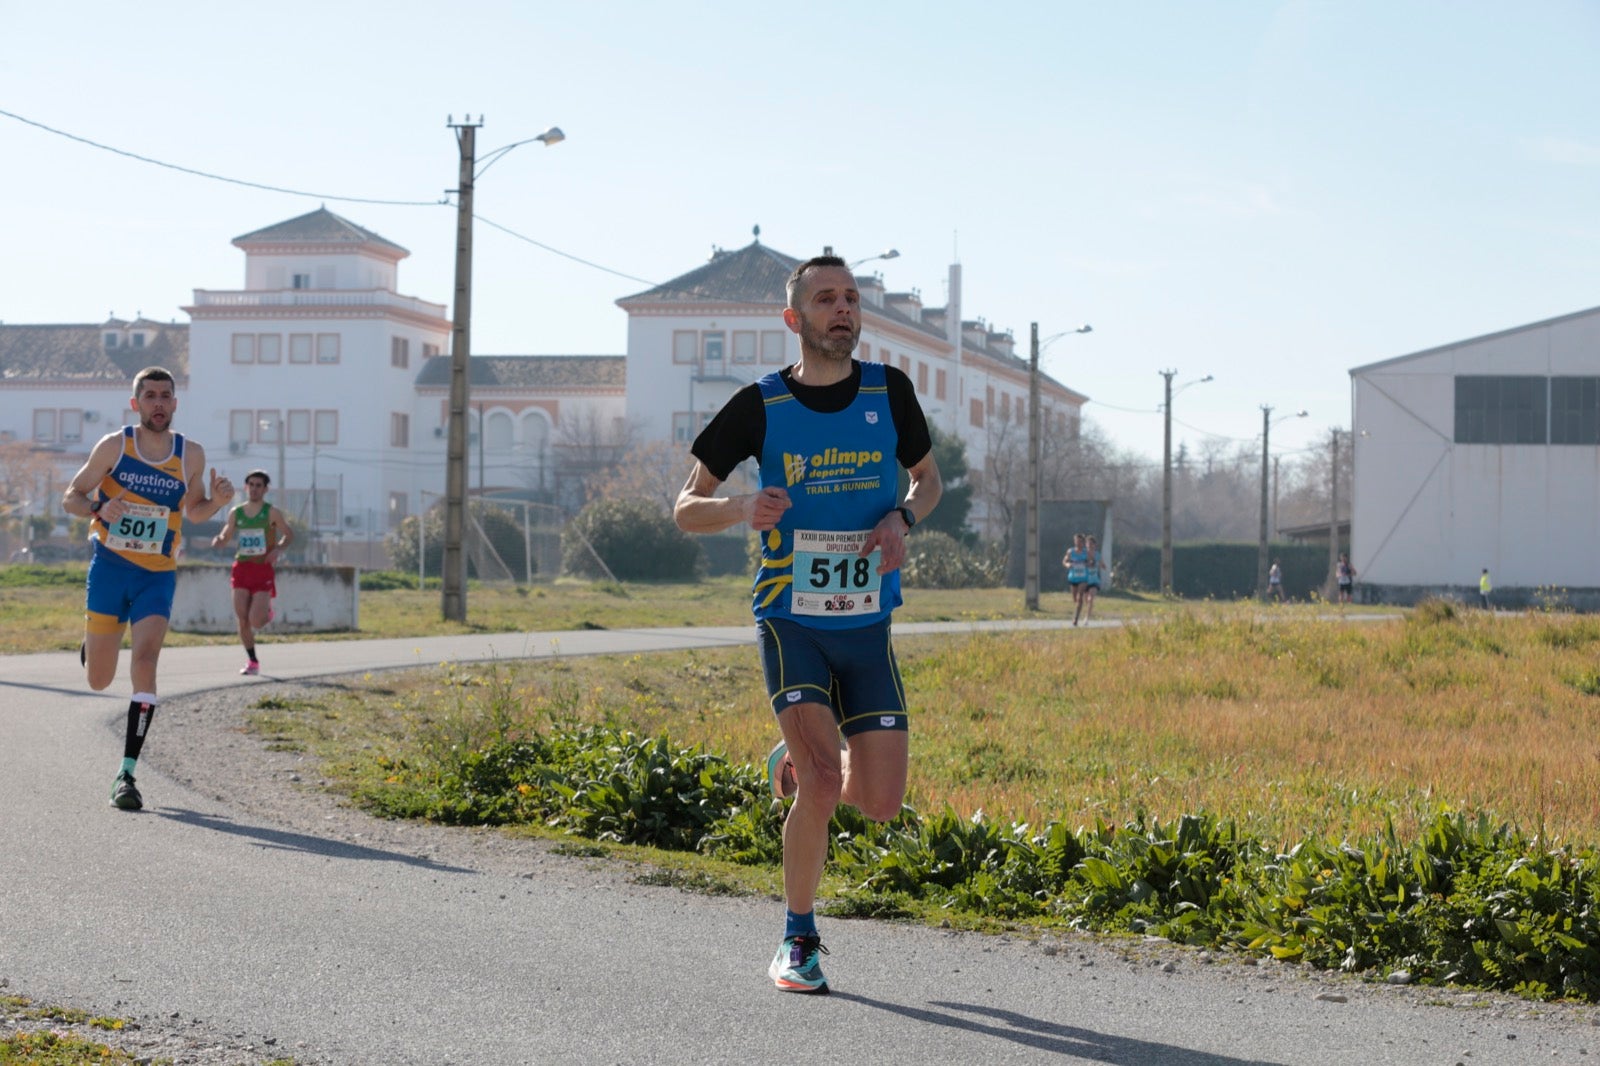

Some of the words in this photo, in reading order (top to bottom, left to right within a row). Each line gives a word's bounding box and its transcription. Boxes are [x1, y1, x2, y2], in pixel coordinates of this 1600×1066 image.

[811, 447, 882, 467] olimpo
[119, 472, 180, 489] agustinos
[809, 467, 855, 478] deportes
[806, 485, 832, 495] TRAIL
[833, 484, 840, 493] &
[842, 480, 880, 491] RUNNING
[119, 517, 155, 538] 501
[801, 533, 817, 541] XXXIII
[818, 534, 835, 542] GRAN
[835, 534, 857, 542] PREMIO
[809, 557, 870, 588] 518
